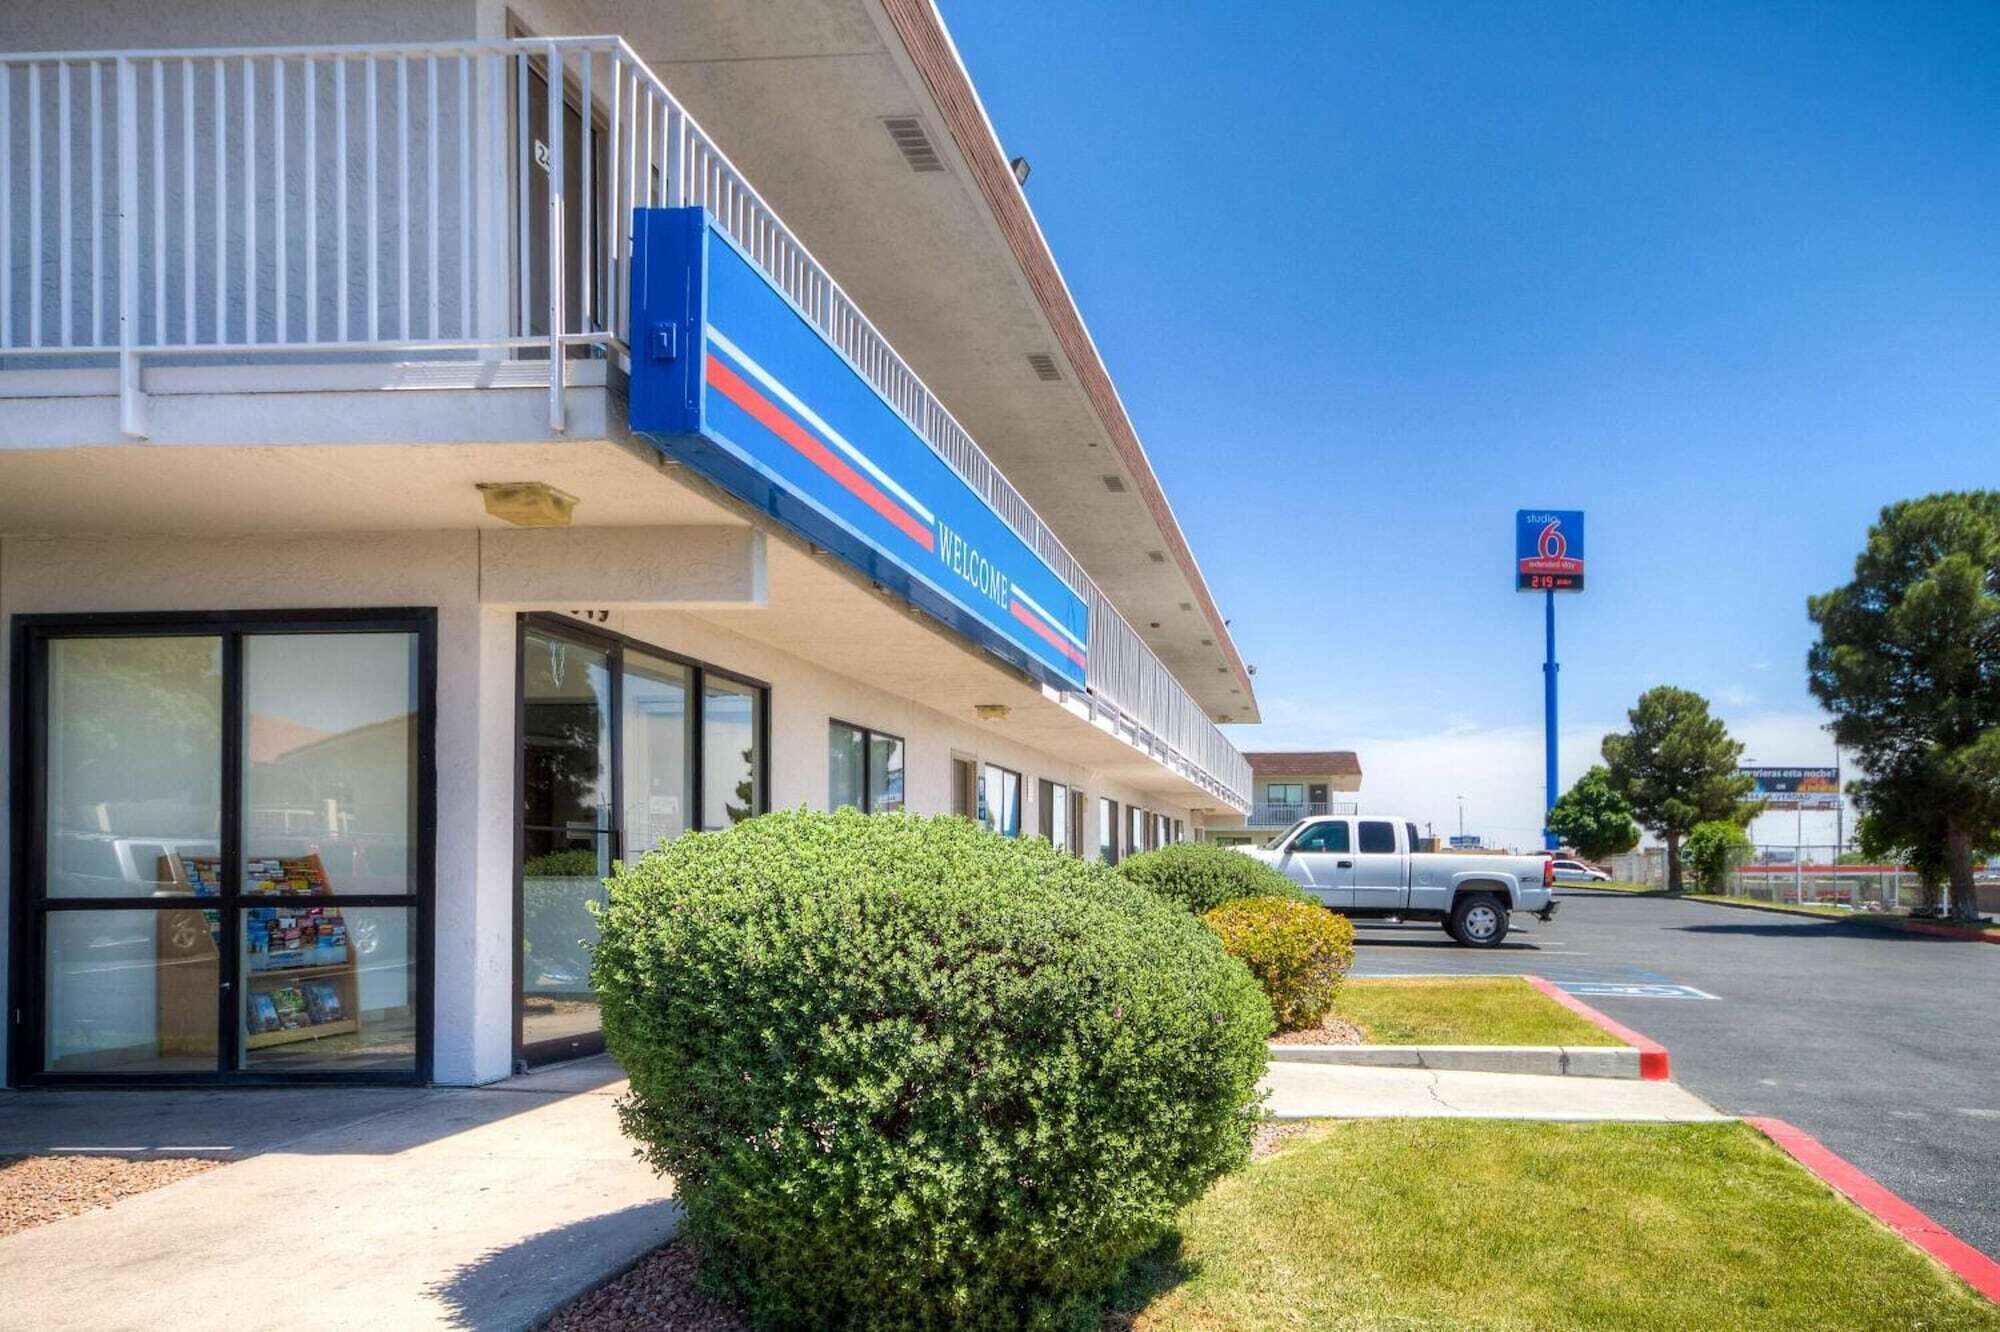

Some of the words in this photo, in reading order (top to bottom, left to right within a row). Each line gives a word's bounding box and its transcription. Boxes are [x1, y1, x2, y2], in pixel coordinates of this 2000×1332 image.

[1526, 513, 1558, 524] studio
[1537, 520, 1567, 560] 6
[938, 520, 1008, 611] WELCOME
[1531, 575, 1553, 588] 219
